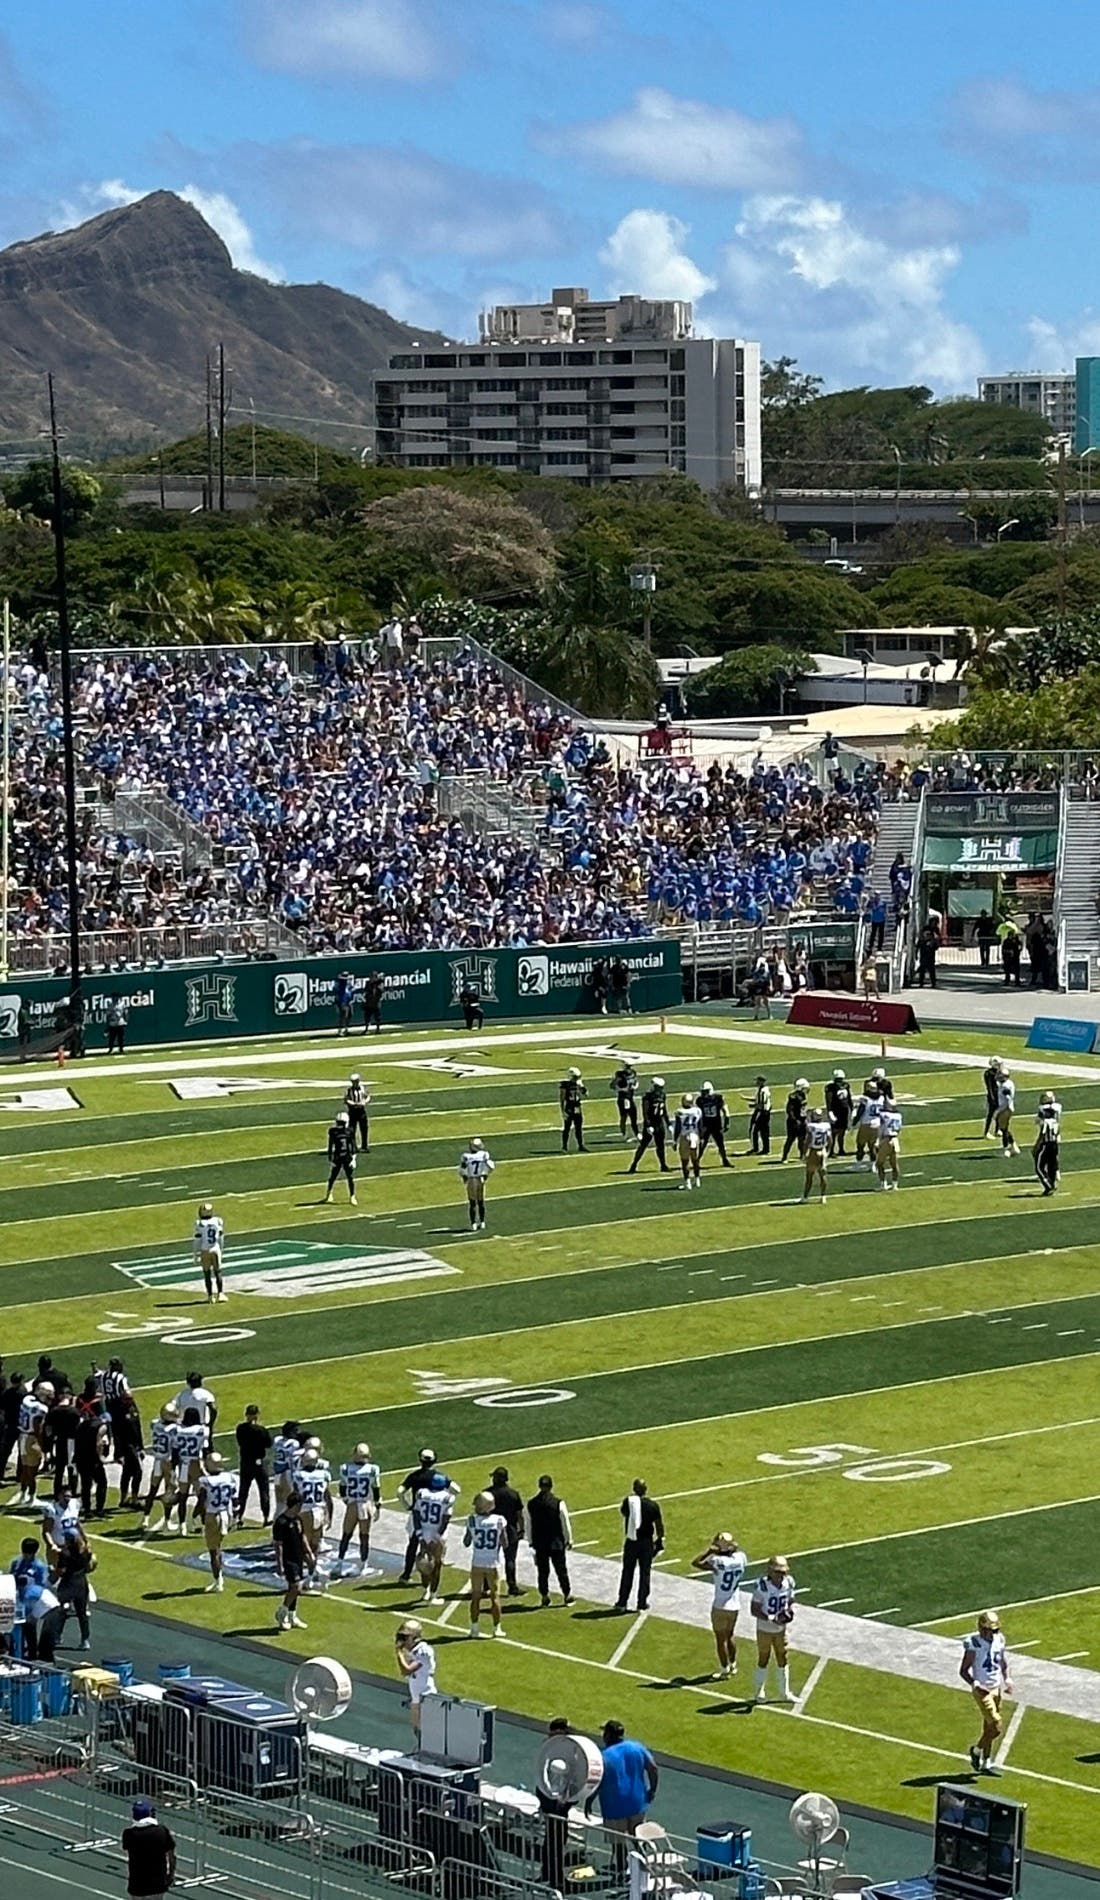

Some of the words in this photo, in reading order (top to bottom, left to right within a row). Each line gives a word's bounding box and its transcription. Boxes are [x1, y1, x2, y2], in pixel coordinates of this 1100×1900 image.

[550, 957, 596, 976] Hawaii
[468, 1160, 479, 1177] 7
[206, 1228, 217, 1245] 9
[412, 1376, 577, 1408] 40
[177, 1435, 199, 1457] 22
[757, 1443, 952, 1483] 50
[303, 1482, 324, 1504] 26
[347, 1477, 370, 1499] 23
[420, 1501, 442, 1525] 39
[474, 1529, 498, 1550] 39
